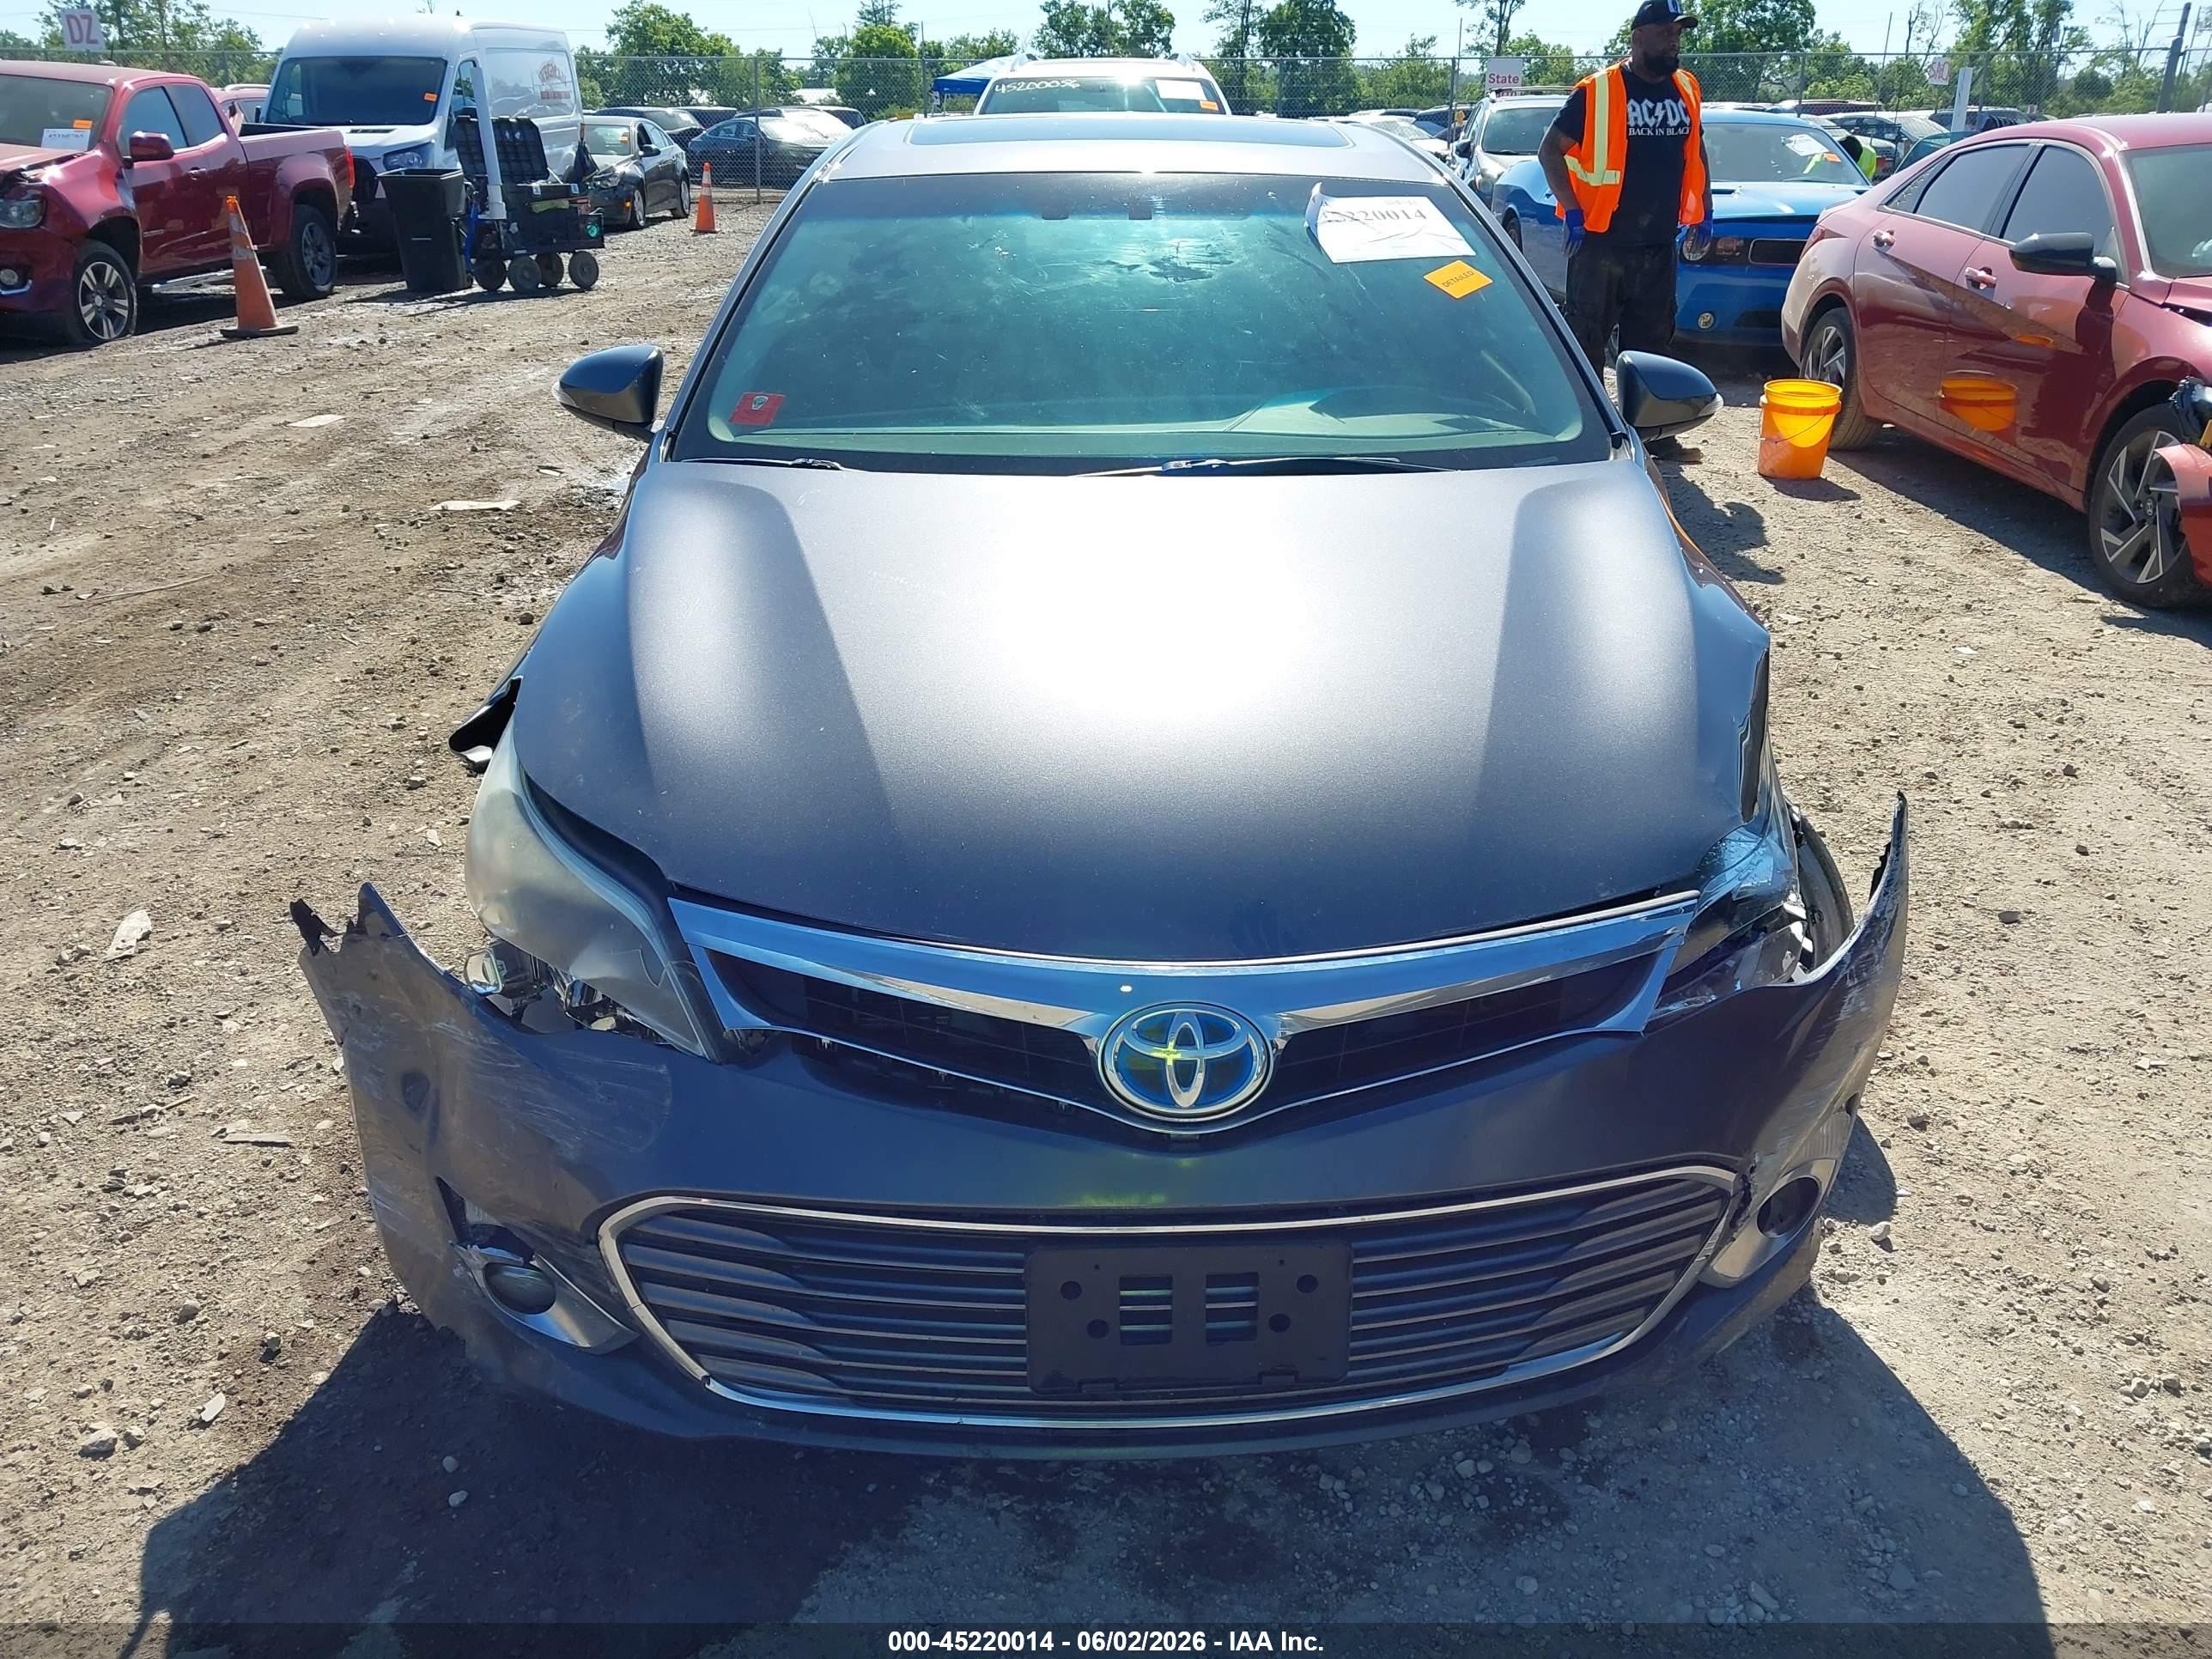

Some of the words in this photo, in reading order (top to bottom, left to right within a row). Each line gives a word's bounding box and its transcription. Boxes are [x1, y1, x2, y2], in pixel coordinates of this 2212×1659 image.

[65, 14, 99, 44] DZ
[1488, 73, 1519, 84] State
[995, 79, 1081, 94] 45200056
[1628, 127, 1654, 137] BACK
[1656, 127, 1665, 137] IN
[1442, 270, 1474, 288] DETAILED
